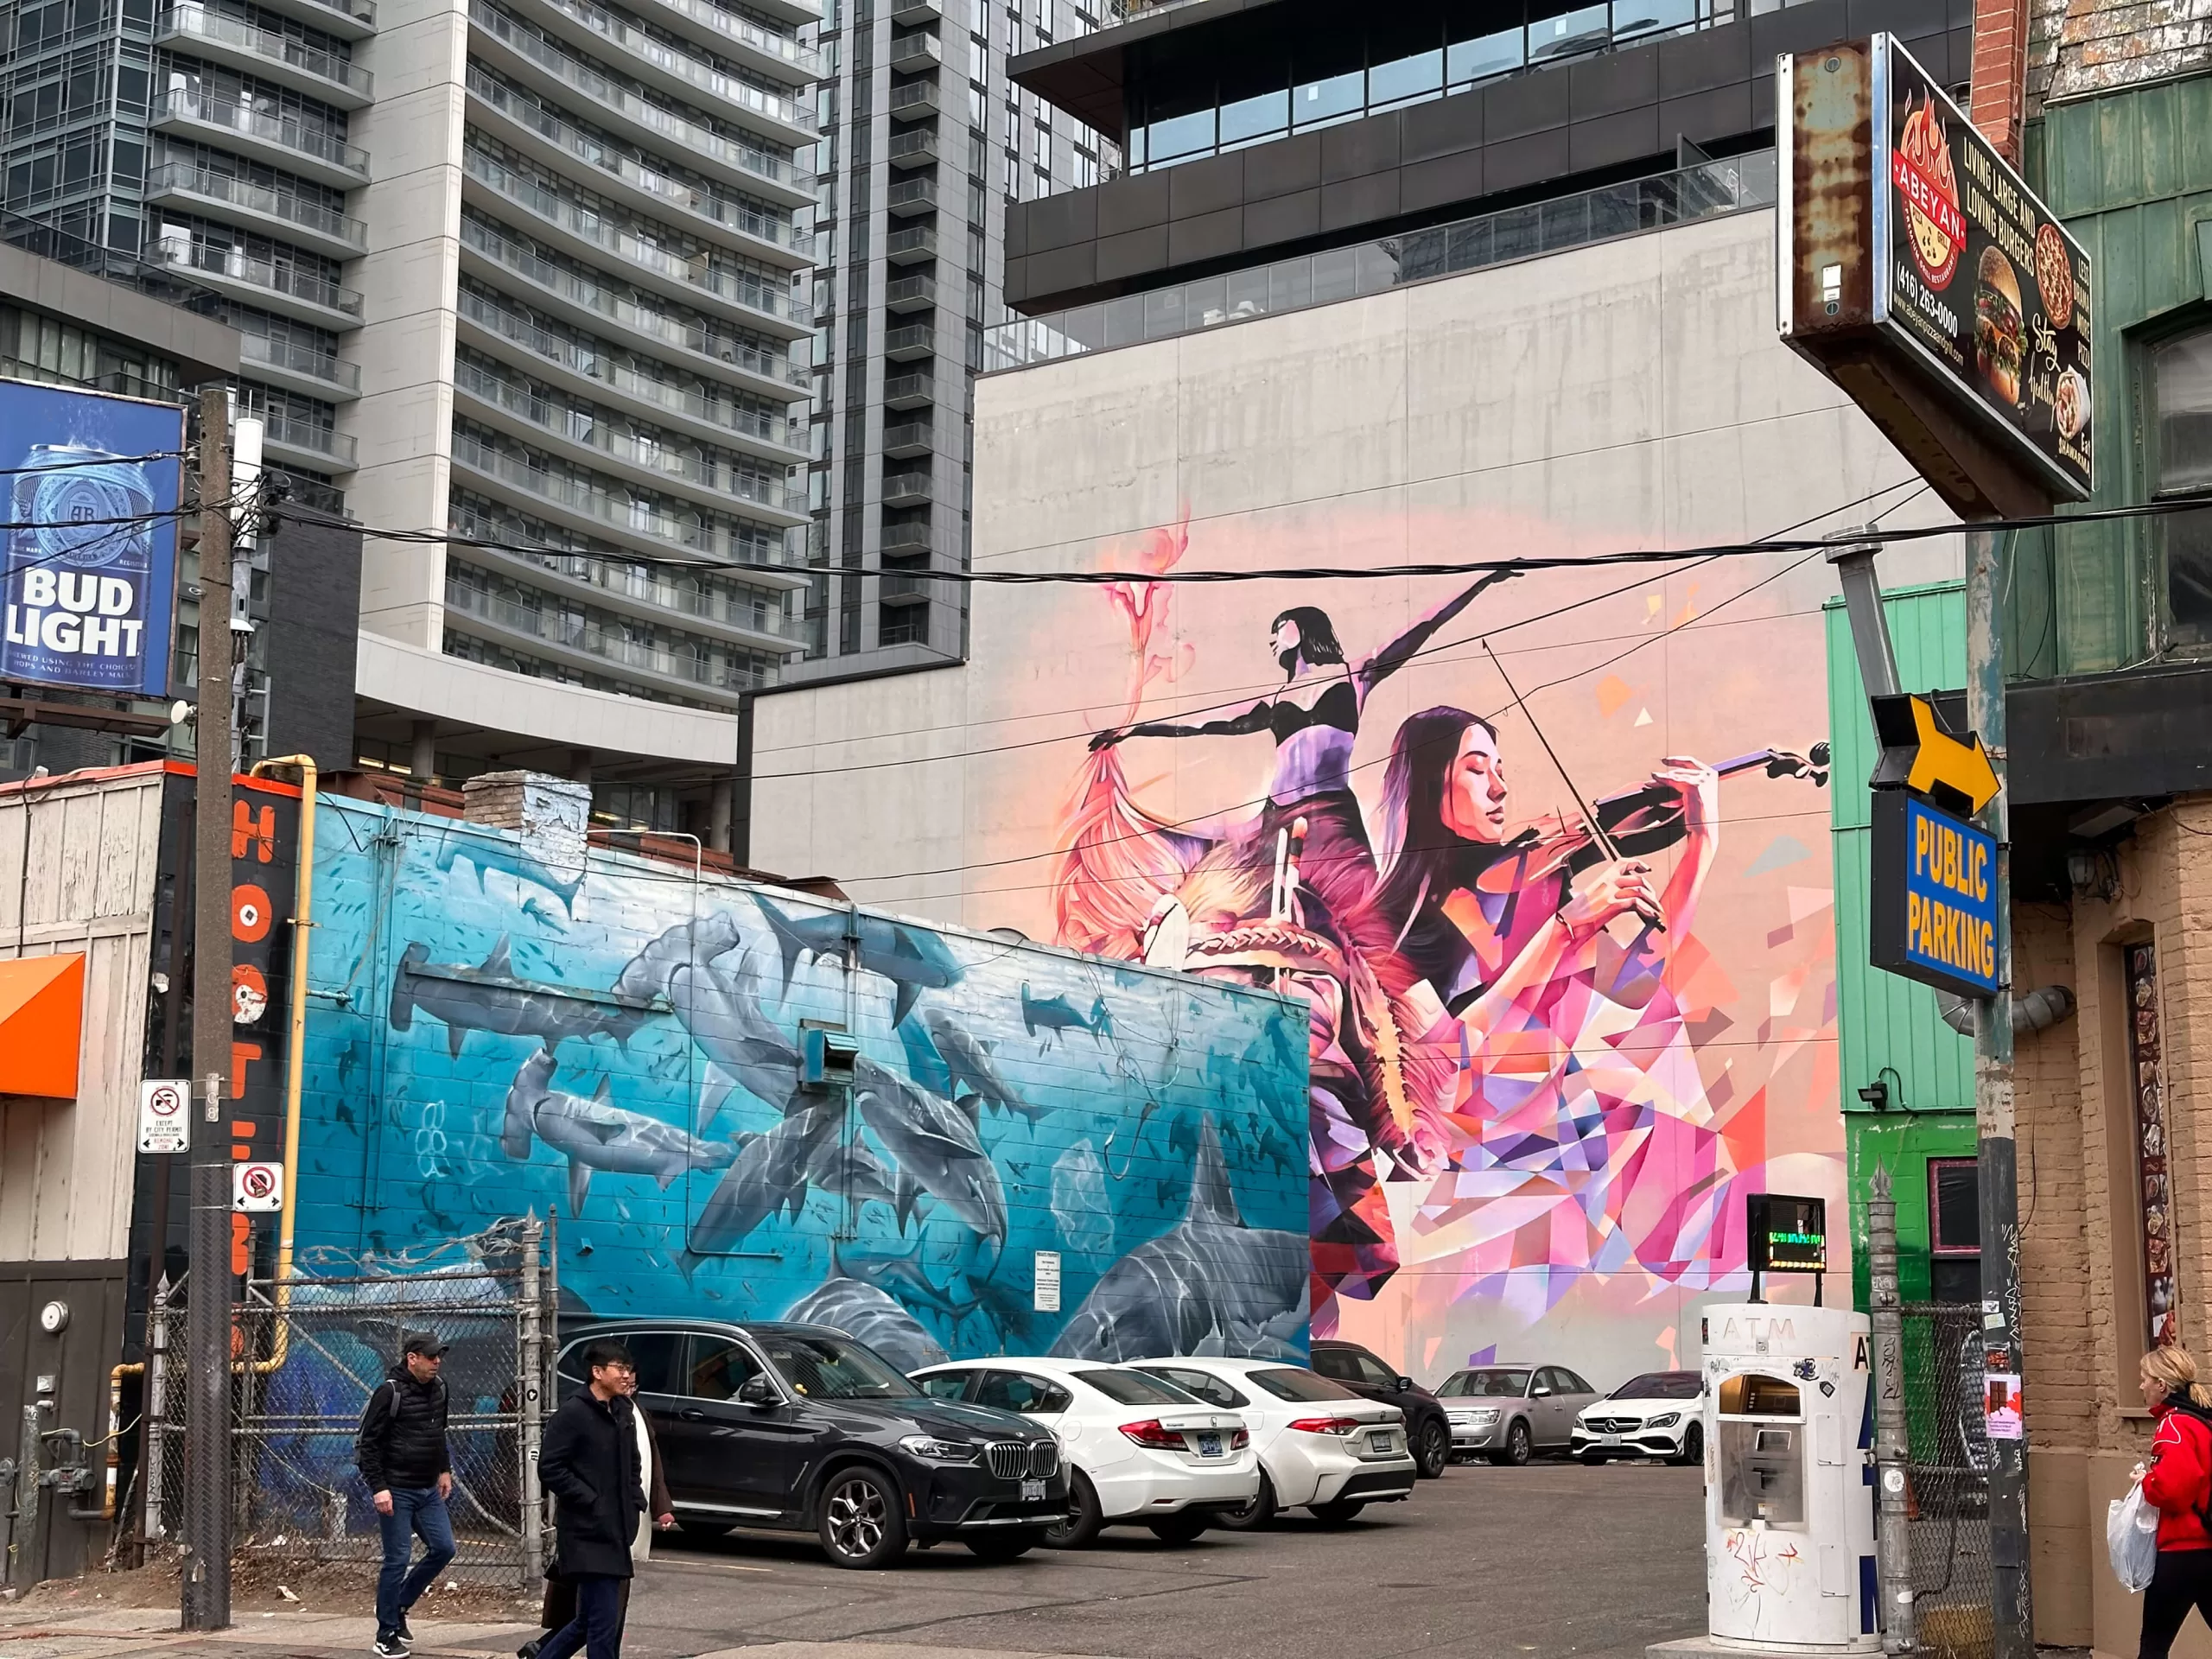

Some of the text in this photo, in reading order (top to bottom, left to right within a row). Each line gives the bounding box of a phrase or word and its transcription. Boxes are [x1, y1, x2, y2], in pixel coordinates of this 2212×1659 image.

[1899, 162, 1961, 241] ABEYAN
[1964, 136, 2036, 239] LIVING LARGE AND
[1937, 231, 1948, 251] GRILL
[1967, 181, 2035, 277] LOVING BURGERS
[1897, 260, 1958, 339] (416) 263-0000
[2031, 312, 2062, 372] Stay
[2058, 436, 2091, 479] SHAWARMA
[23, 567, 134, 616] BUD
[6, 604, 143, 658] LIGHT
[10, 651, 39, 662] EWED
[38, 664, 61, 673] AND
[1916, 814, 1988, 902] PUBLIC
[1907, 890, 1994, 978] PARKING
[1723, 1318, 1796, 1339] ATM
